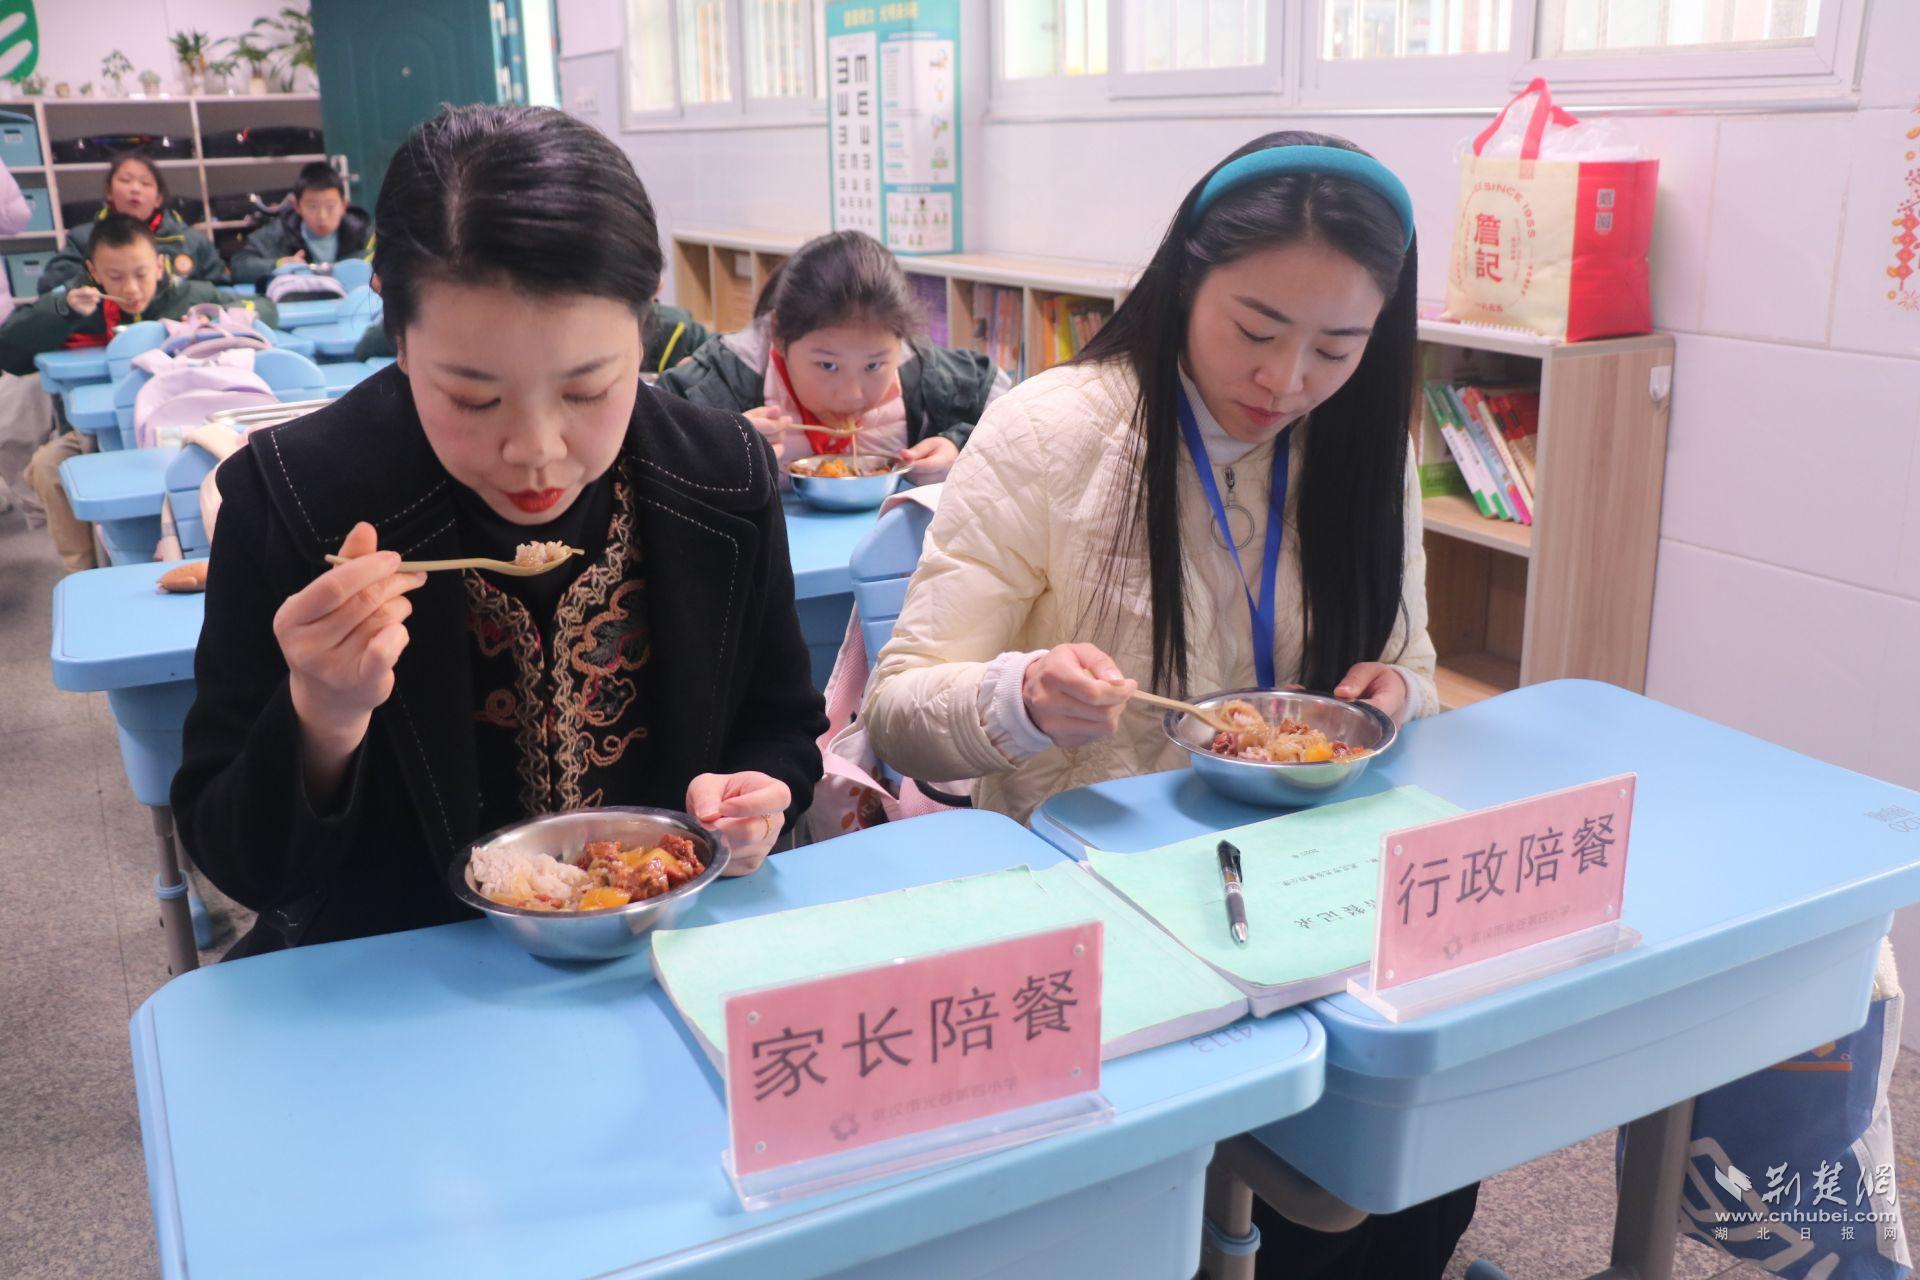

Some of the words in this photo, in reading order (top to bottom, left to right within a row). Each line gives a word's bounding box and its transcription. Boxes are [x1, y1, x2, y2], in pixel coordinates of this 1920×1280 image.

[1484, 182, 1523, 202] SINCE
[1396, 812, 1616, 925] 行政陪餐
[751, 969, 1080, 1102] 家长陪餐
